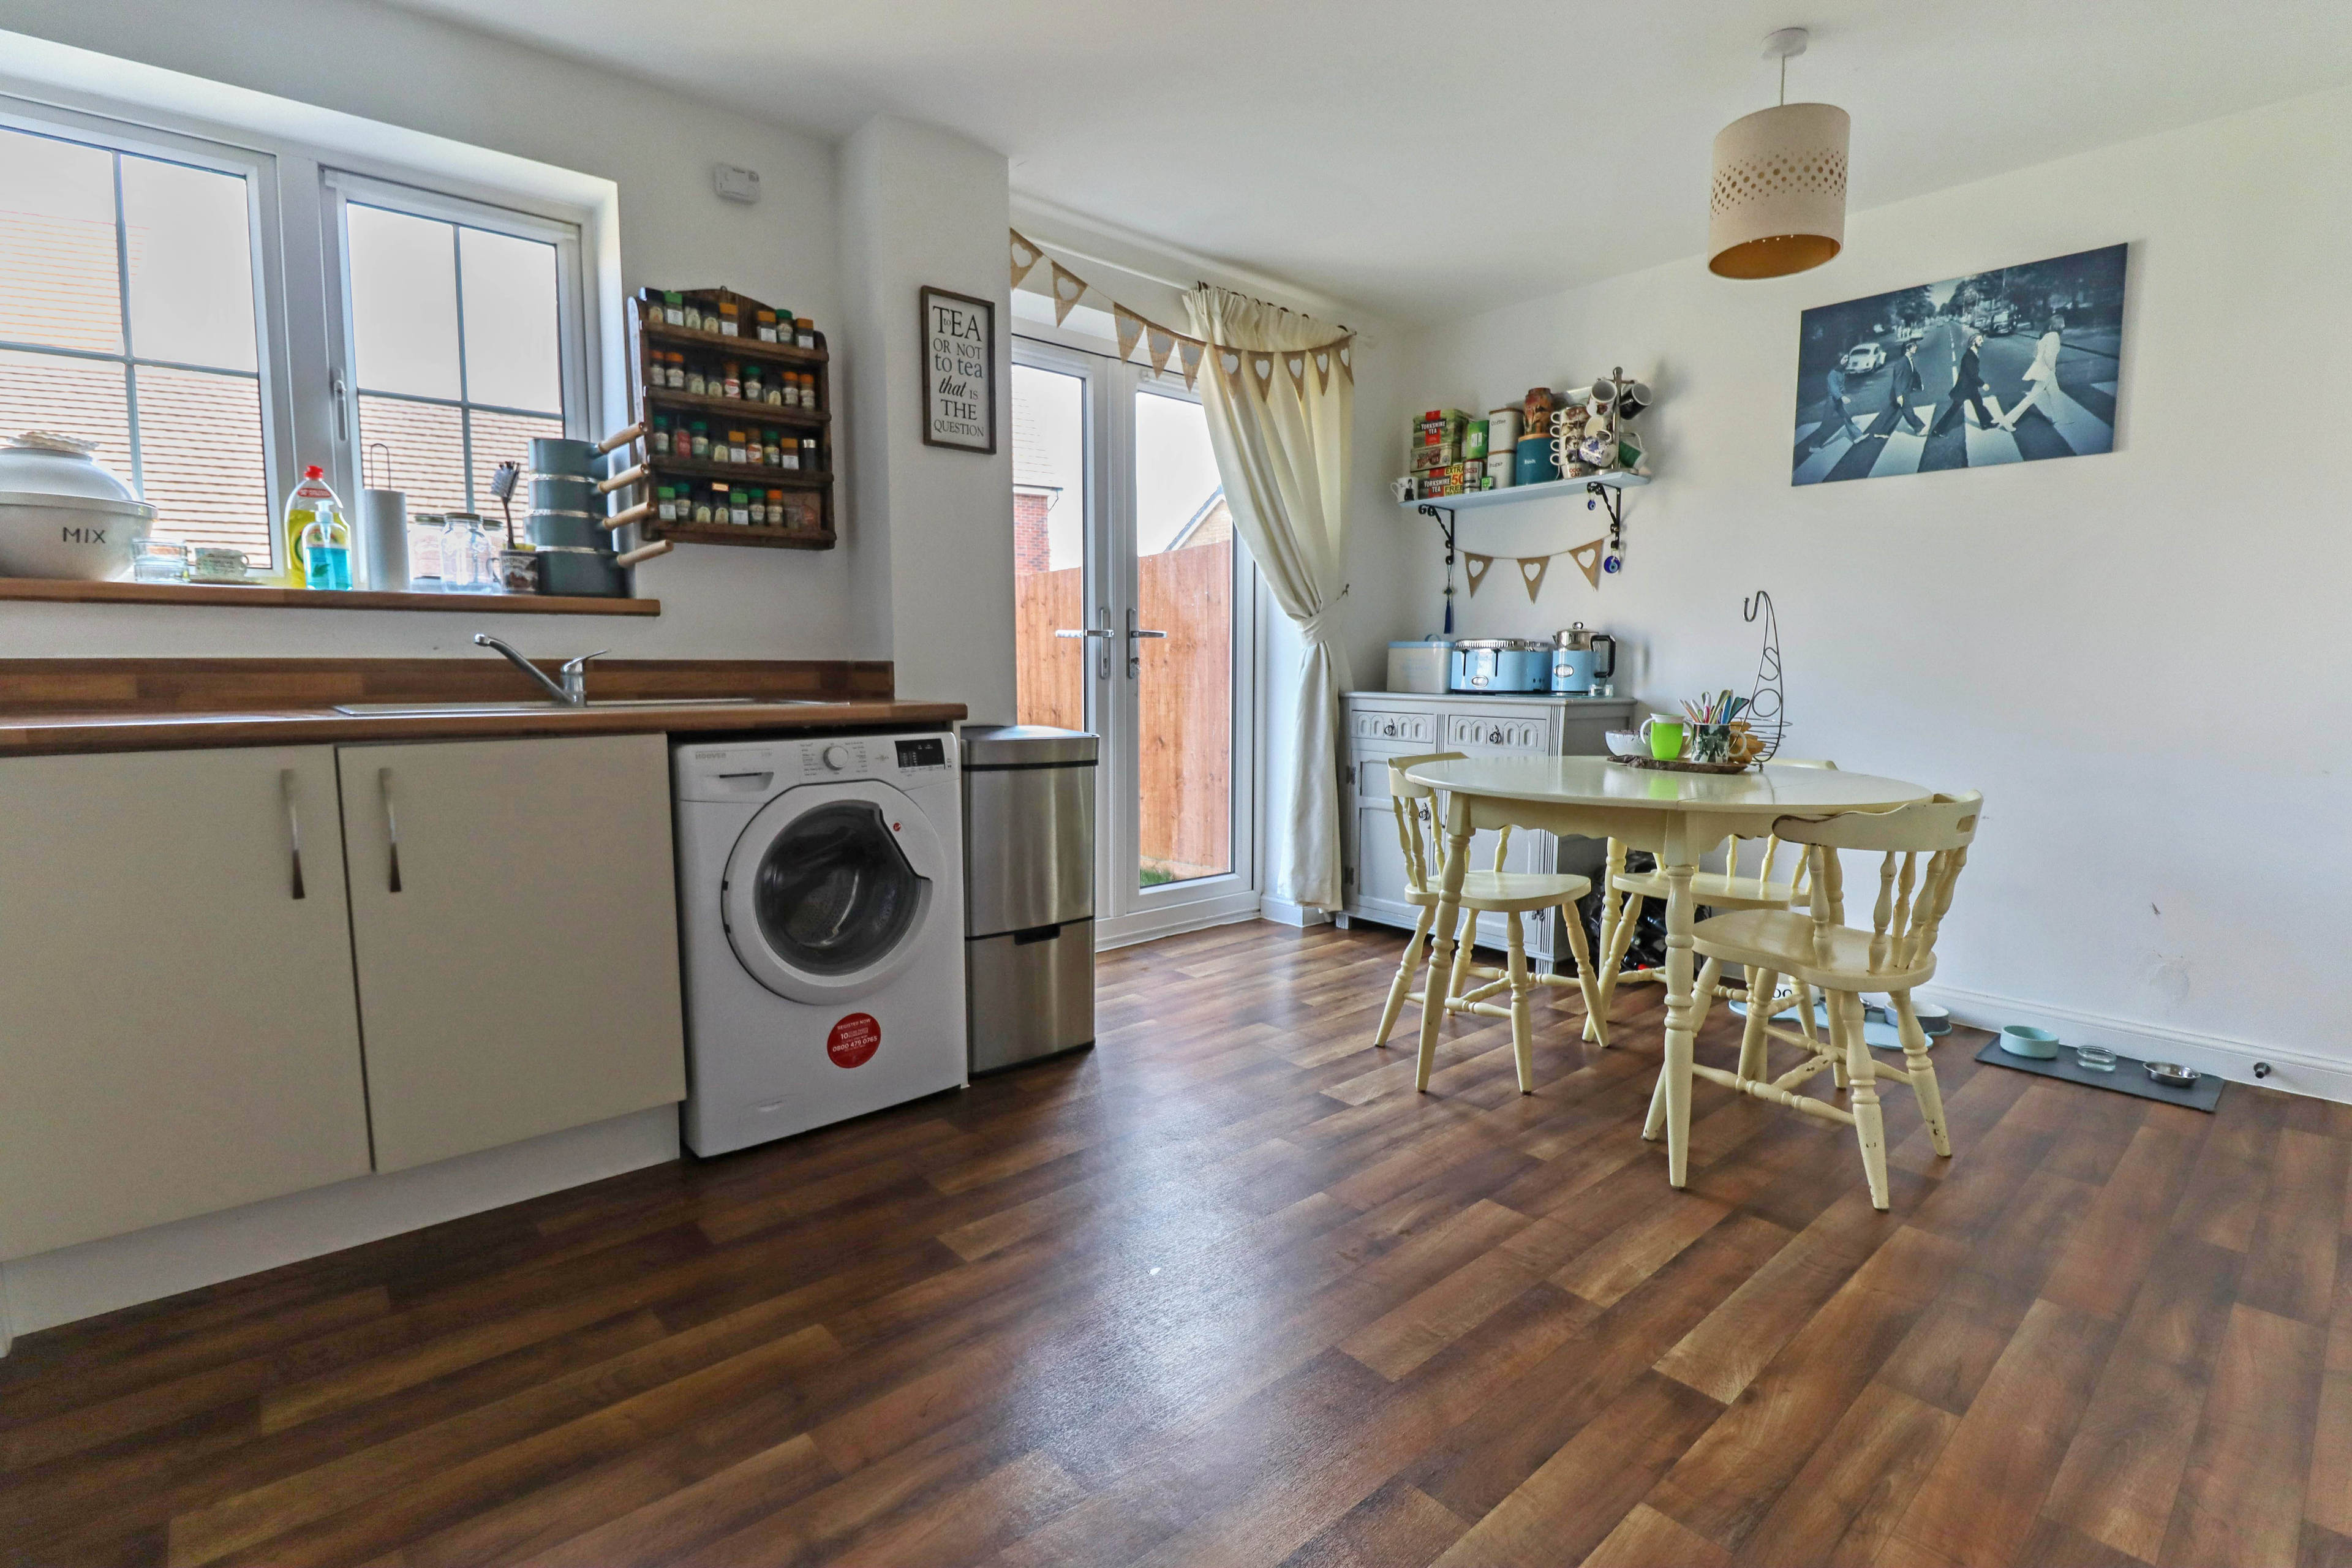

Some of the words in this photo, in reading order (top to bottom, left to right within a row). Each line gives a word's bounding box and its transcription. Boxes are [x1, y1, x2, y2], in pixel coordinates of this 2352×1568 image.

[933, 306, 982, 342] TEA
[933, 338, 951, 353] OR
[957, 343, 982, 360] NOT
[935, 353, 952, 372] to
[958, 358, 983, 379] tea
[938, 375, 966, 397] that
[970, 390, 978, 400] IS
[940, 399, 977, 421] THE
[934, 419, 984, 437] QUESTION
[1421, 421, 1446, 430] YORKSHIRE
[1424, 478, 1450, 488] YORKSHIRE
[62, 527, 106, 544] MIX
[833, 1043, 849, 1052] 0800
